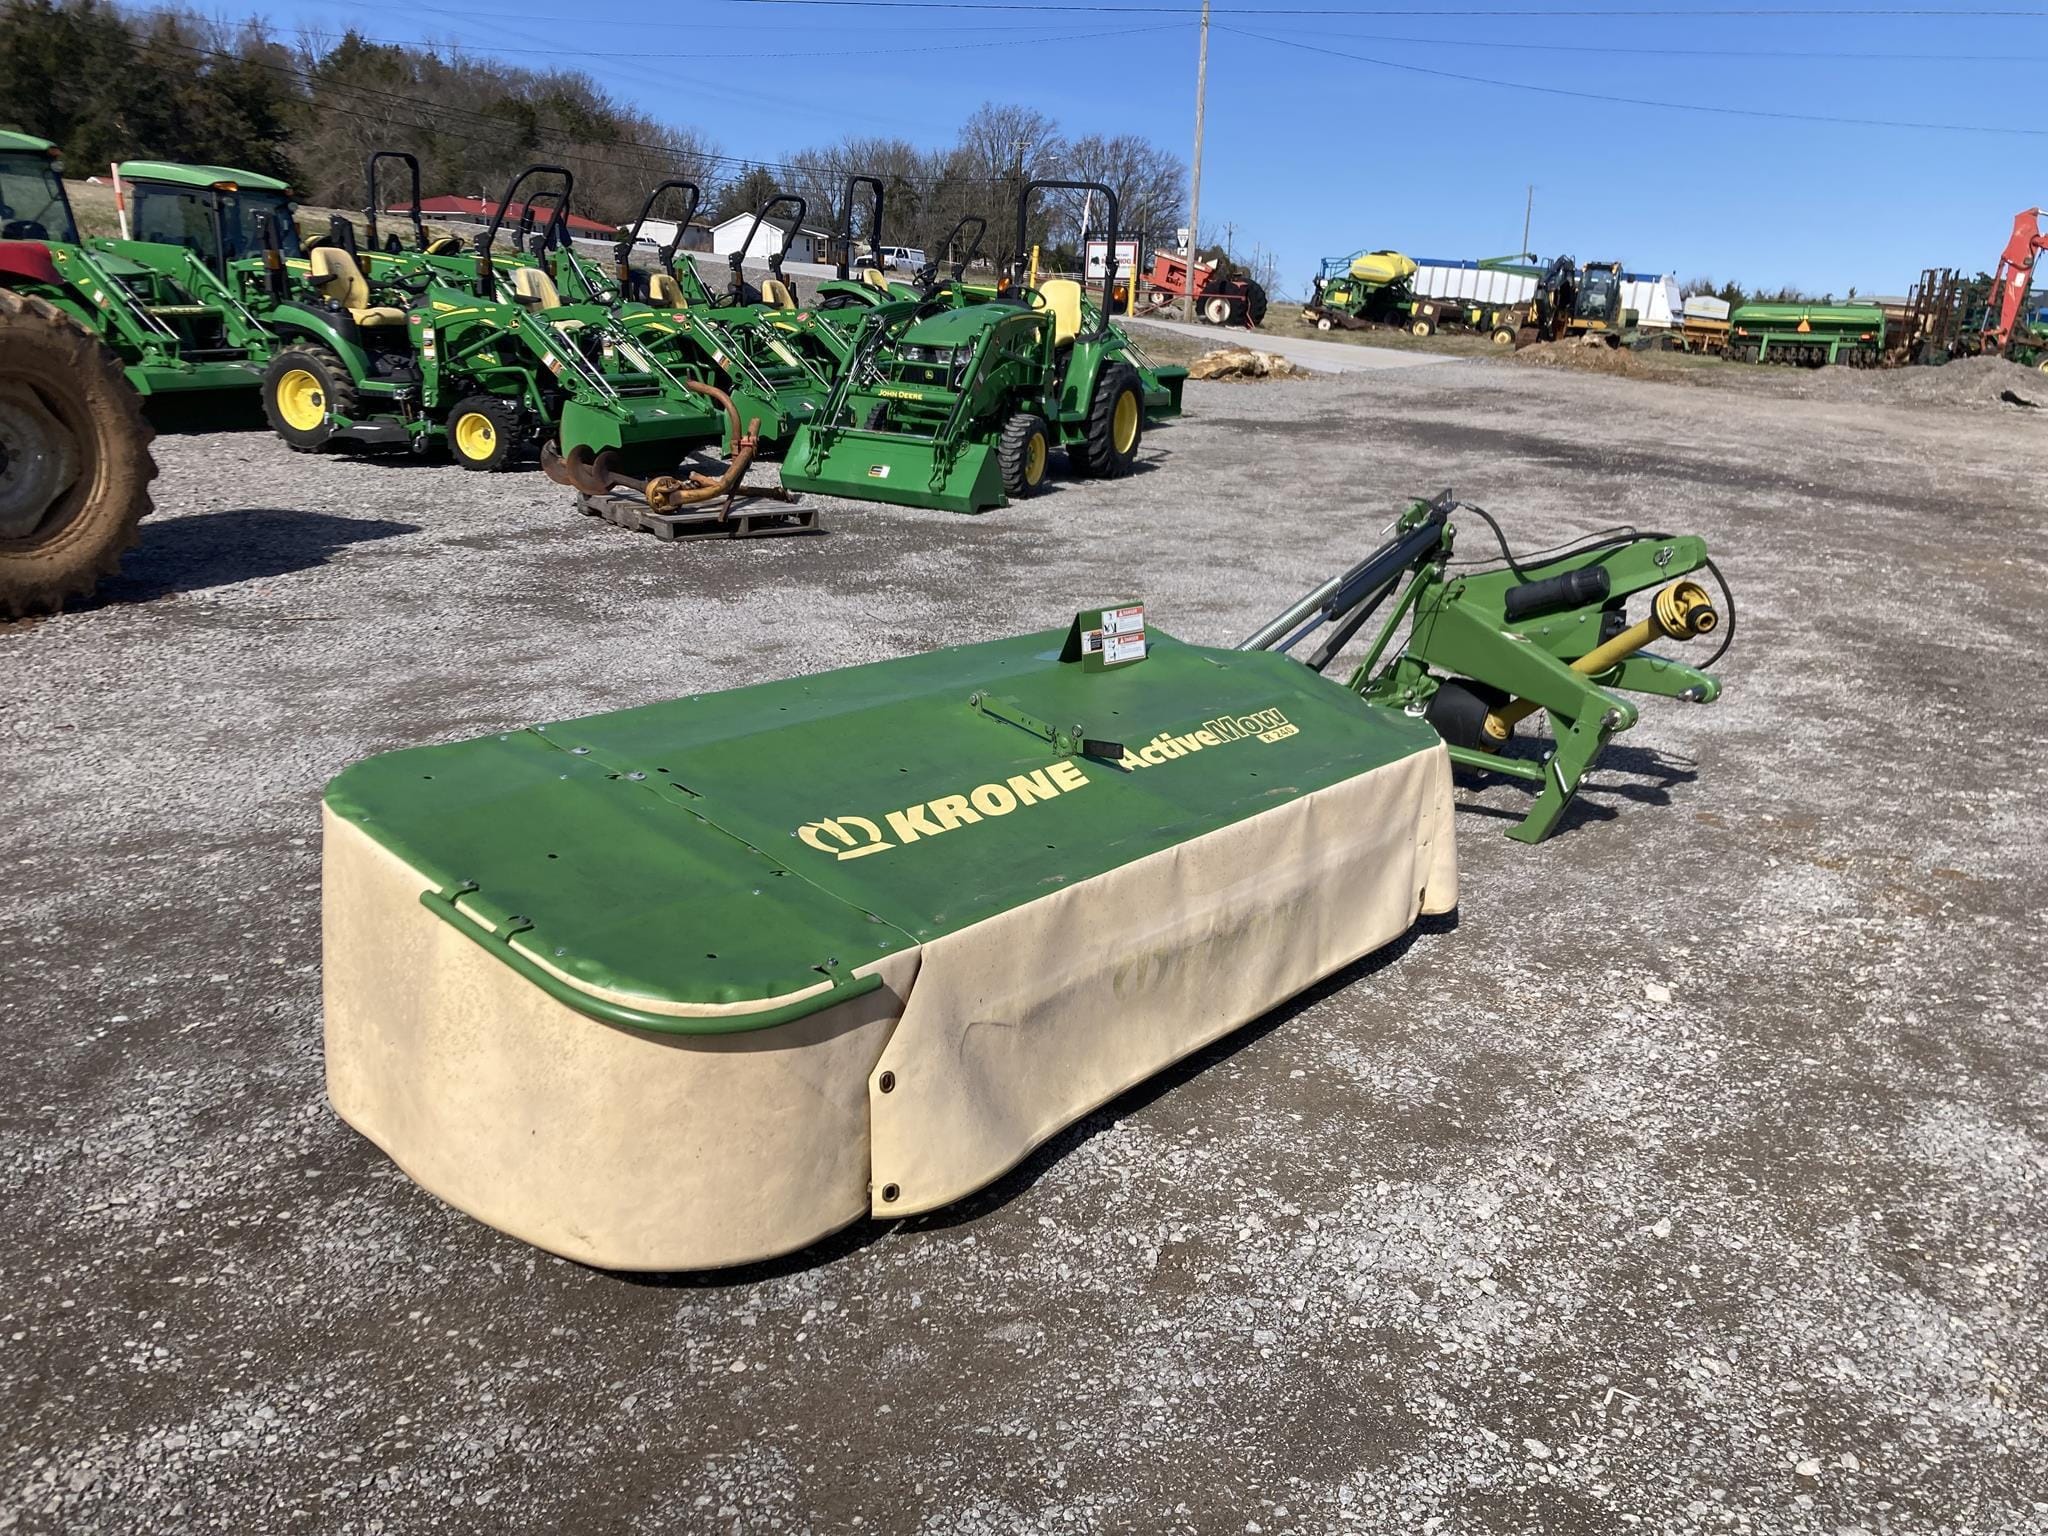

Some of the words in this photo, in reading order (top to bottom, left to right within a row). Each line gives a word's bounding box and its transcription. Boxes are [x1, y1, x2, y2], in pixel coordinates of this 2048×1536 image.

[878, 389, 897, 398] JOHN
[898, 391, 923, 400] DEERE
[1117, 707, 1289, 771] ActiveMow
[1264, 733, 1273, 742] R
[1275, 726, 1295, 738] 240
[885, 760, 1090, 844] KRONE
